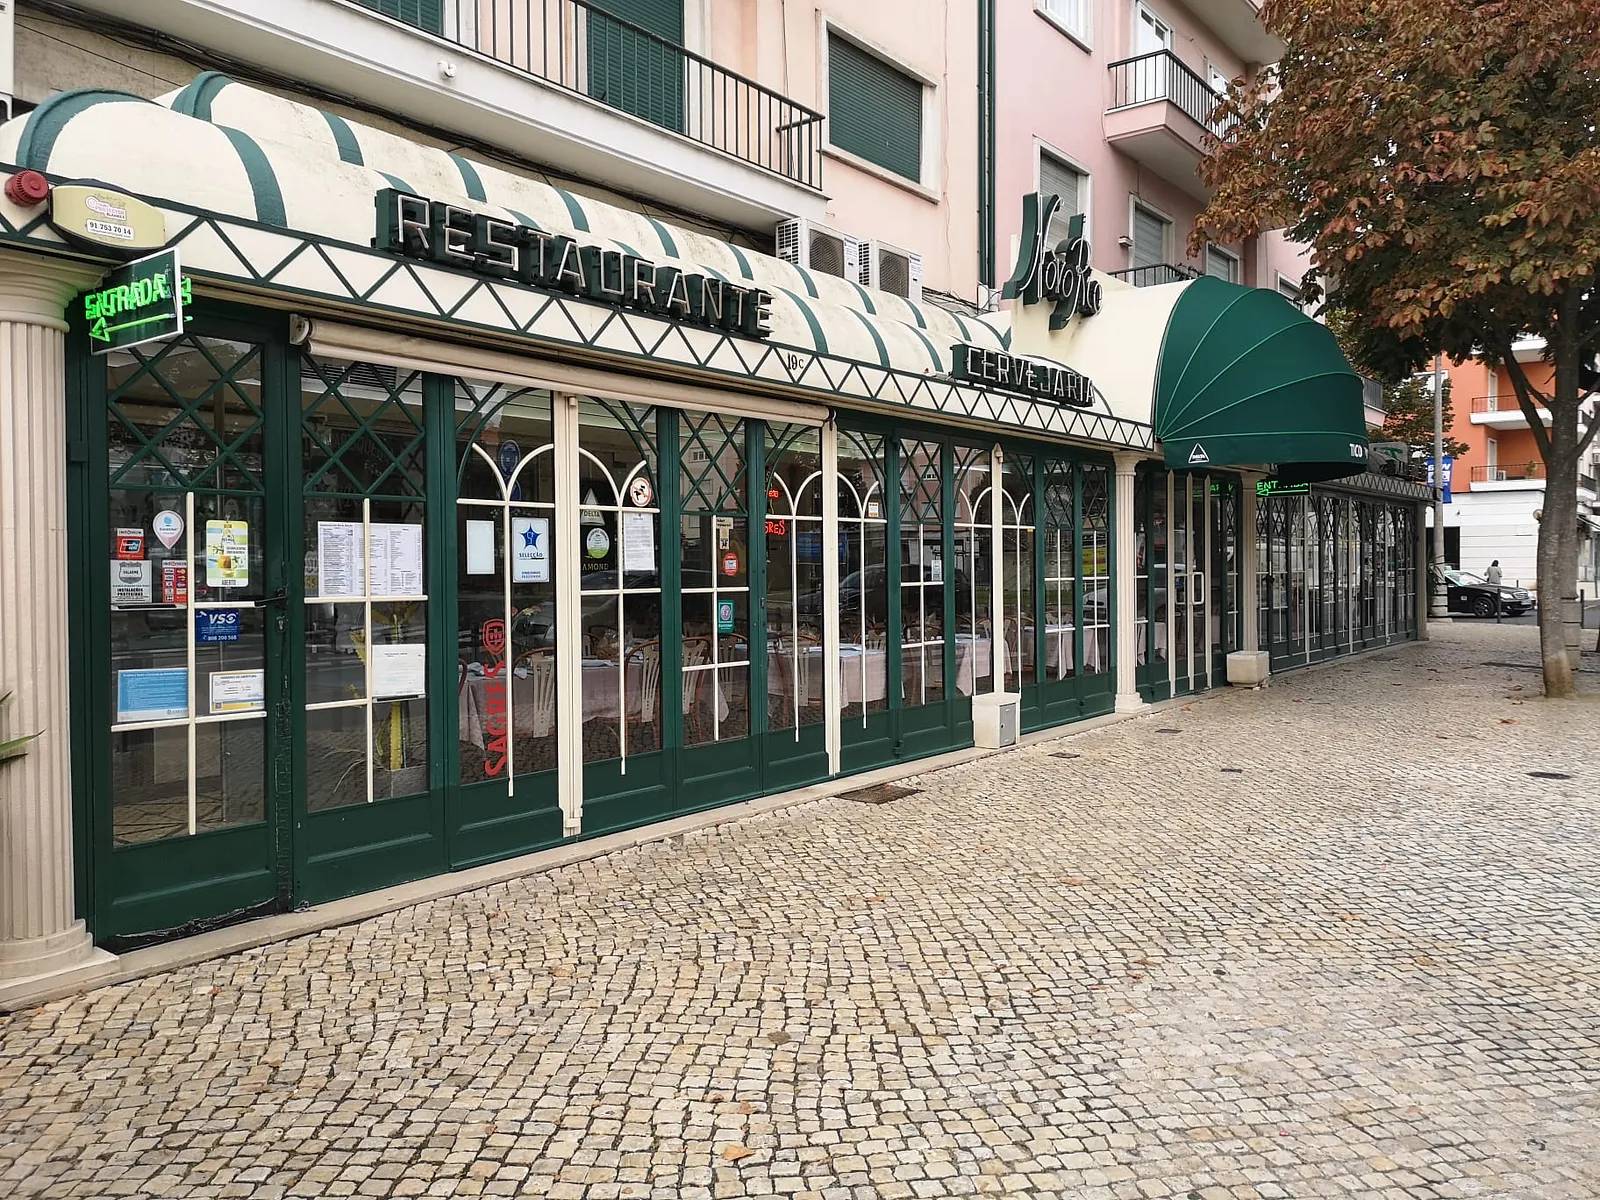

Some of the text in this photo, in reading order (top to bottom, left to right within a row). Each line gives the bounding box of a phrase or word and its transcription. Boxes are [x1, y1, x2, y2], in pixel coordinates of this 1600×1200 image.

[90, 221, 98, 229] 91
[376, 187, 774, 338] RESTAURANTE
[952, 344, 1096, 408] CERVEJARIA
[484, 659, 509, 777] SAGRES
